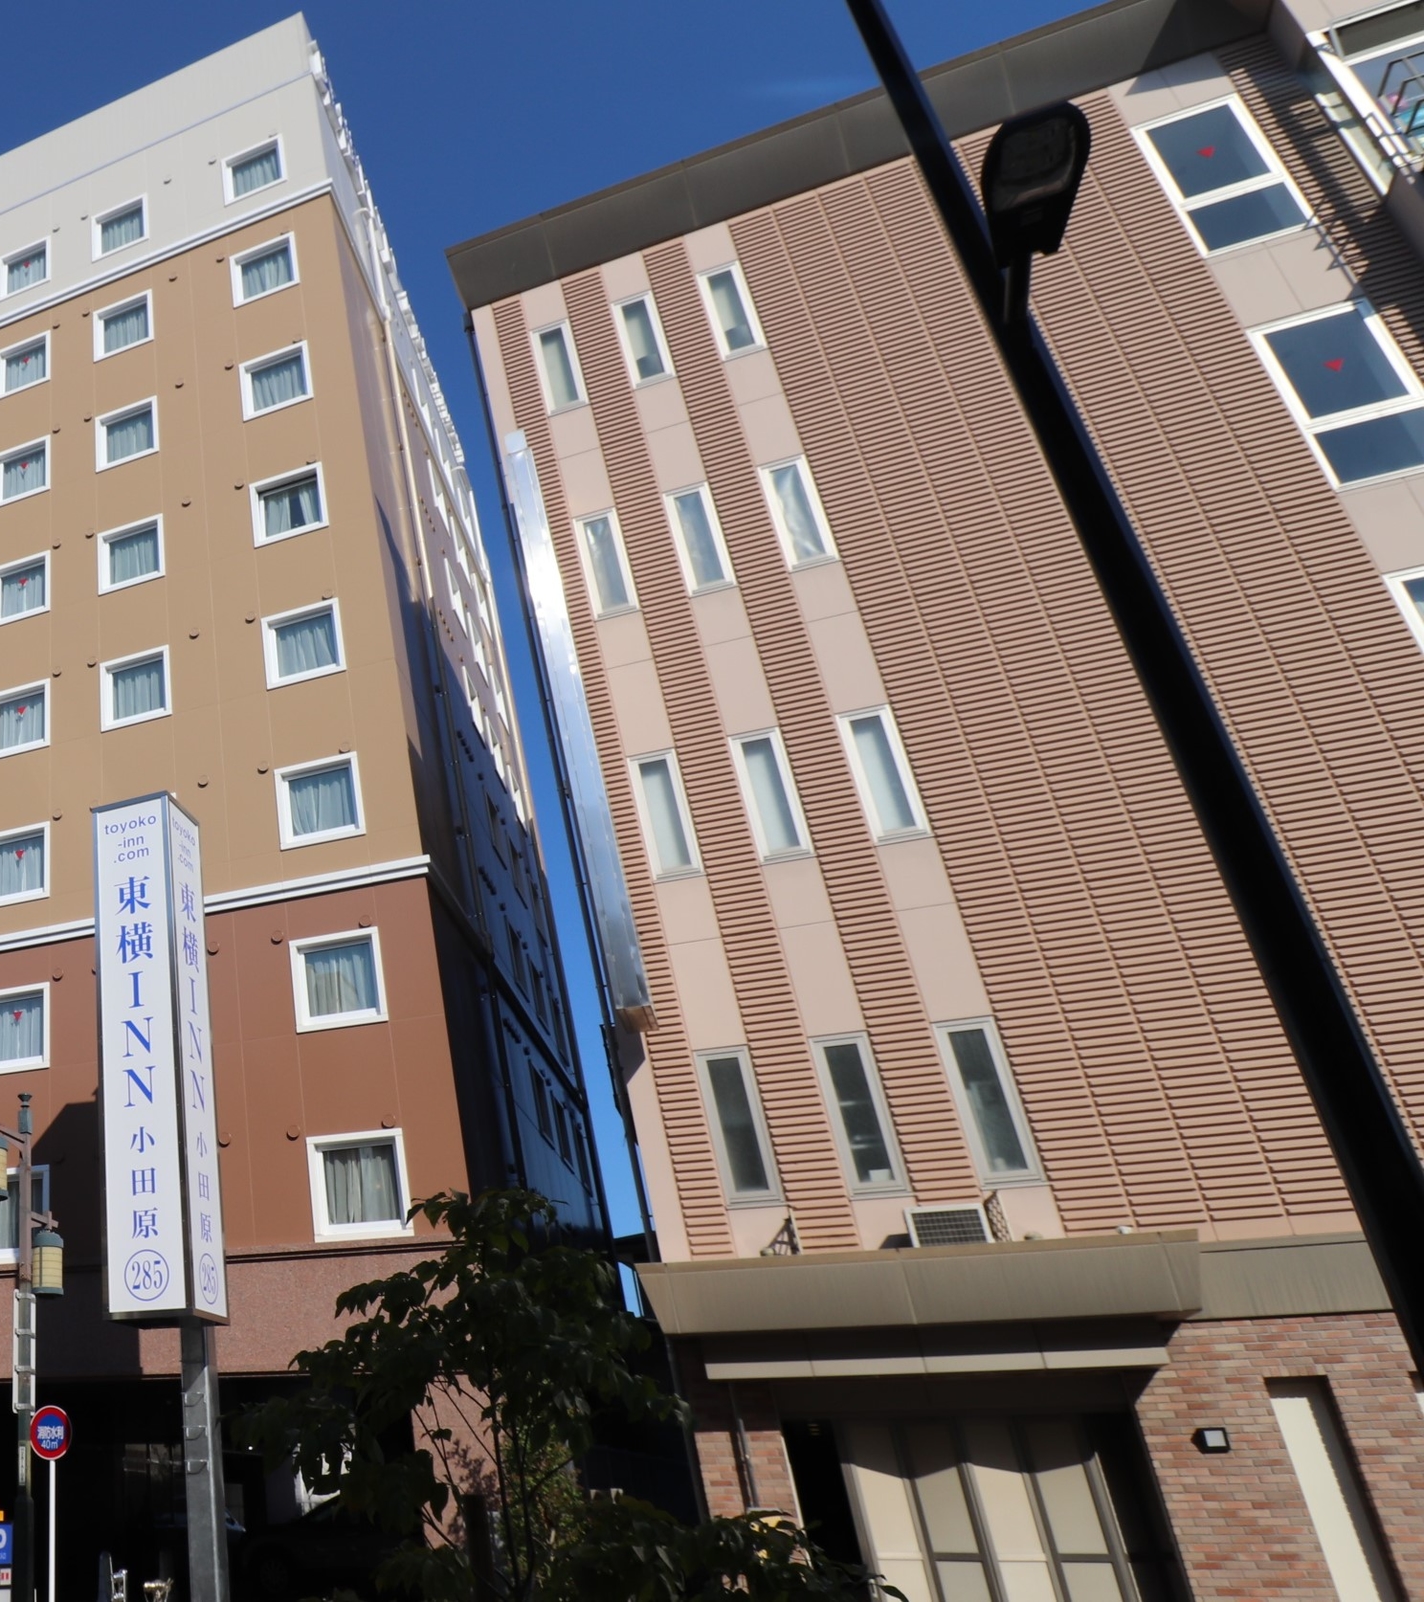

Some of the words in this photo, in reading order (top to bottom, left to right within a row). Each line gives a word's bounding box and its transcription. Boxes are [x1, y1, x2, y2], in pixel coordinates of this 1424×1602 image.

[105, 815, 156, 835] toyoko
[172, 817, 195, 846] toyoko
[114, 847, 149, 863] .com
[118, 836, 144, 848] -inn
[113, 875, 156, 1108] 東横INN
[178, 881, 206, 1115] 東横INN
[195, 1131, 213, 1244] 小田原
[129, 1126, 159, 1240] 小田原
[131, 1258, 164, 1291] 285
[200, 1260, 218, 1297] 285
[37, 1425, 64, 1440] 消防水利
